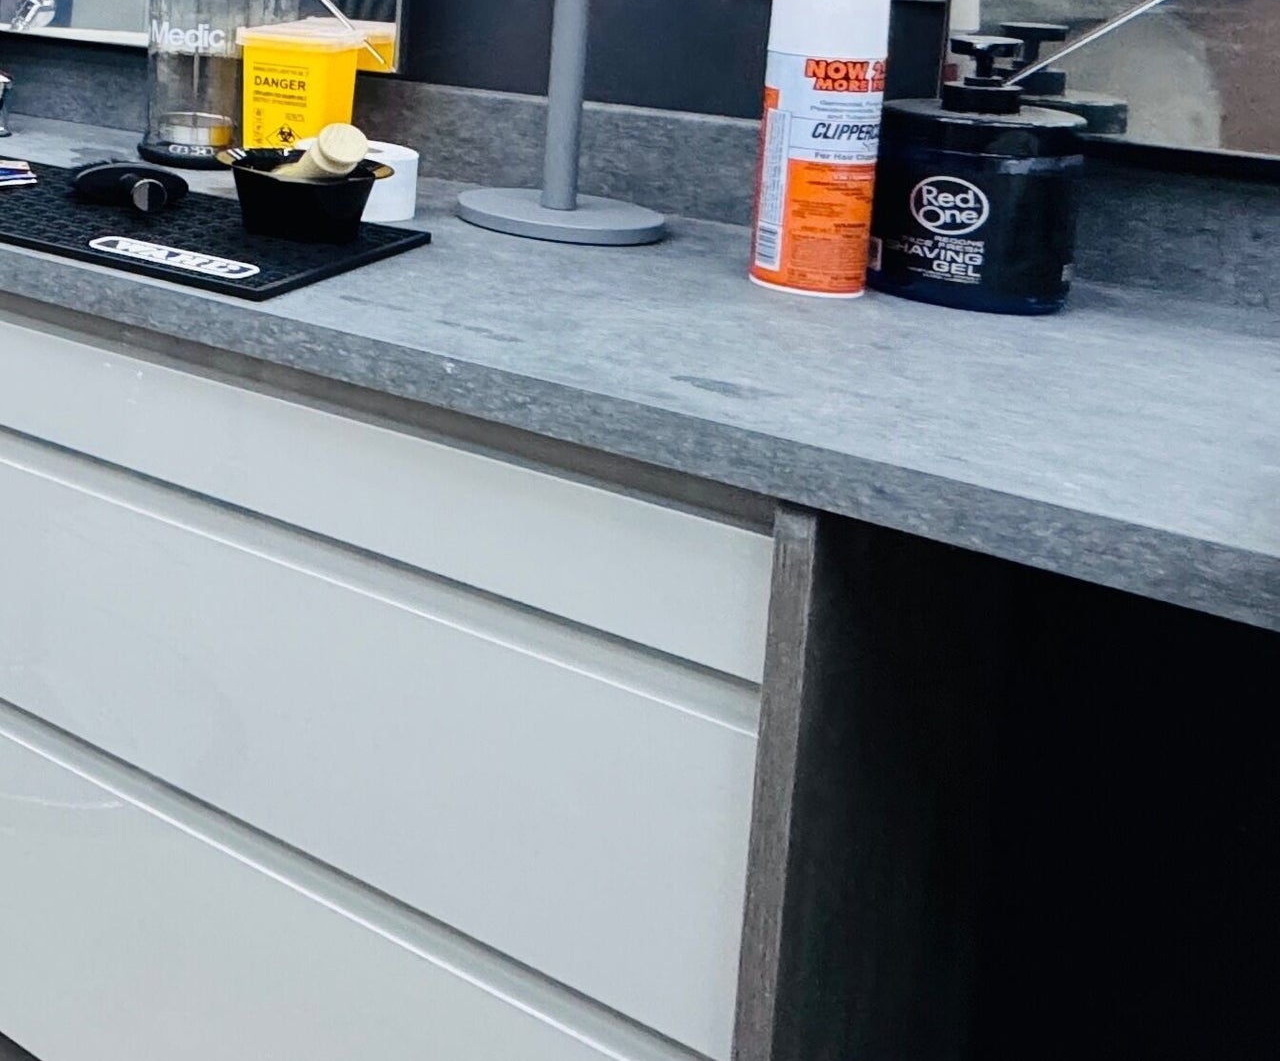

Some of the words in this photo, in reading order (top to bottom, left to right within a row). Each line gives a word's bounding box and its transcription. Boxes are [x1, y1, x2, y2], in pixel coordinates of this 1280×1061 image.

[152, 19, 225, 48] Medic
[805, 59, 869, 79] NOW
[253, 75, 307, 91] DANGER
[813, 78, 869, 92] MORE
[921, 185, 976, 207] Red
[918, 205, 979, 227] One
[932, 260, 981, 277] GEL
